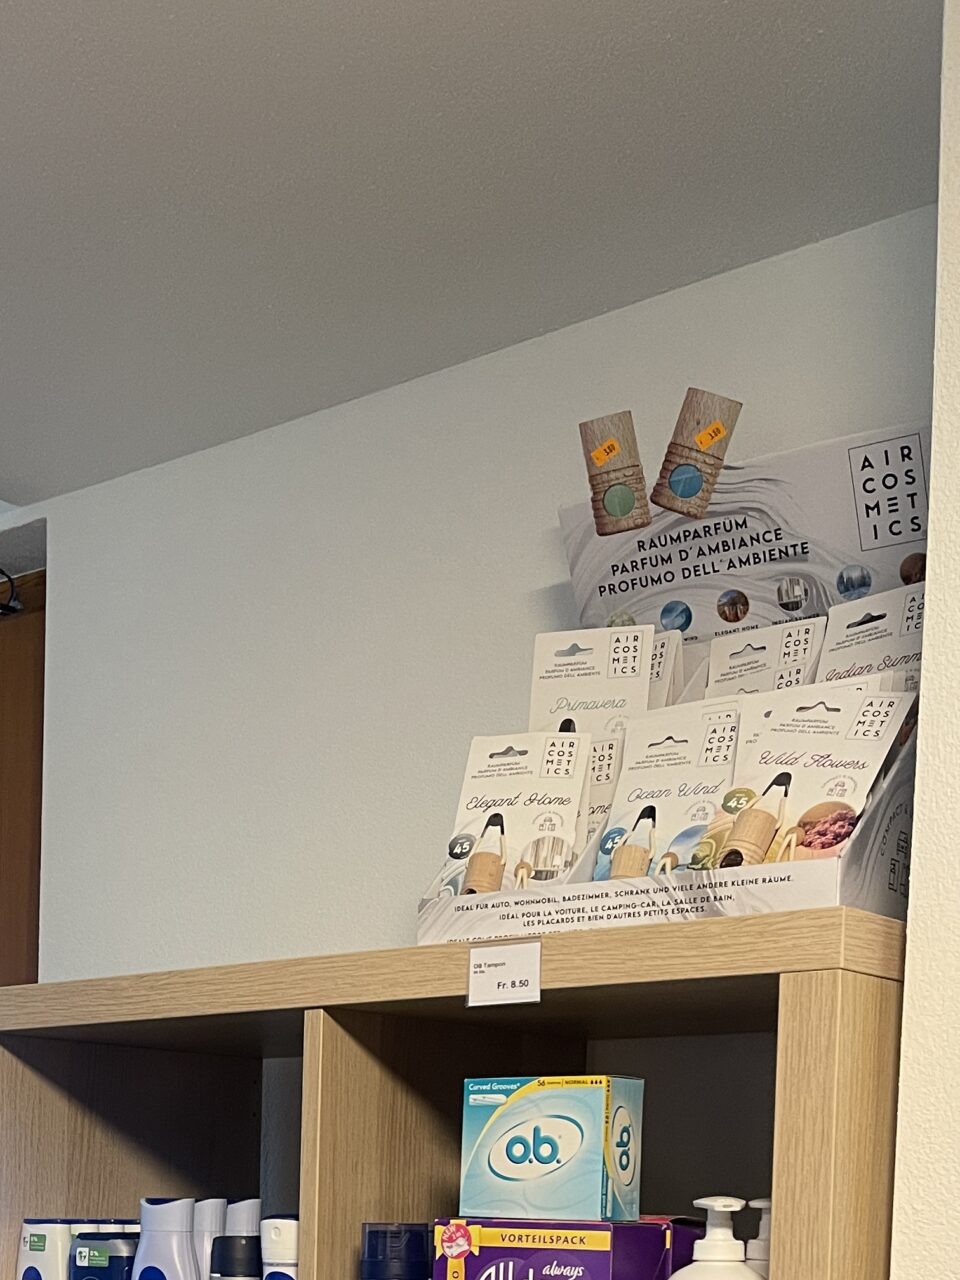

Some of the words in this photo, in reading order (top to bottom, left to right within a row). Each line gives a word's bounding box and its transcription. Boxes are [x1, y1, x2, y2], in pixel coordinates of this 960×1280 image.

[861, 446, 913, 471] AIR
[862, 470, 916, 494] COS
[637, 517, 748, 553] RAUMPARFÜM
[873, 517, 922, 540] ICS
[611, 552, 673, 577] PARFUM
[598, 571, 675, 597] PROFUMO
[714, 628, 740, 637] ELEGANT
[741, 624, 759, 632] HOME
[614, 635, 639, 644] AIR
[613, 645, 639, 654] COS
[613, 666, 637, 675] ICS
[826, 662, 873, 682] Indian
[877, 651, 923, 671] Summ
[778, 668, 802, 680] AIR
[777, 678, 800, 690] COS
[549, 696, 627, 714] Primavera
[867, 701, 895, 709] AIR
[862, 709, 890, 718] COS
[854, 729, 880, 737] ICS
[550, 741, 575, 749] AIR
[548, 750, 573, 758] COS
[759, 750, 800, 766] Wild
[804, 754, 869, 771] Flowers
[546, 768, 570, 776] ICS
[627, 788, 672, 803] Ocean
[678, 778, 726, 798] Wind
[466, 792, 522, 813] Elegant
[524, 792, 572, 807] Home
[727, 796, 747, 809] 45
[454, 841, 470, 855] 45
[454, 904, 475, 913] IDEAL
[514, 896, 560, 907] WOHNMOBIL,
[562, 891, 612, 903] BADEZIMMER,
[614, 888, 651, 898] SCHRANK
[653, 886, 670, 894] UND
[672, 884, 694, 892] VIELE
[697, 881, 728, 890] ANDERE
[732, 877, 759, 887] KLEINE
[522, 910, 541, 919] POUR
[543, 909, 553, 917] LA
[590, 905, 599, 913] LE
[661, 899, 671, 907] LA
[674, 897, 697, 905] SALLE
[523, 919, 535, 927] LES
[537, 916, 575, 926] PLACARDS
[577, 915, 585, 923] ET
[588, 913, 605, 922] BIEN
[644, 908, 669, 917] PETITS
[671, 906, 707, 915] ESPACES.
[510, 979, 529, 989] 8.50
[469, 1083, 491, 1091] Curved
[500, 1233, 587, 1245] VORTEILSPACK
[542, 1260, 585, 1280] always
